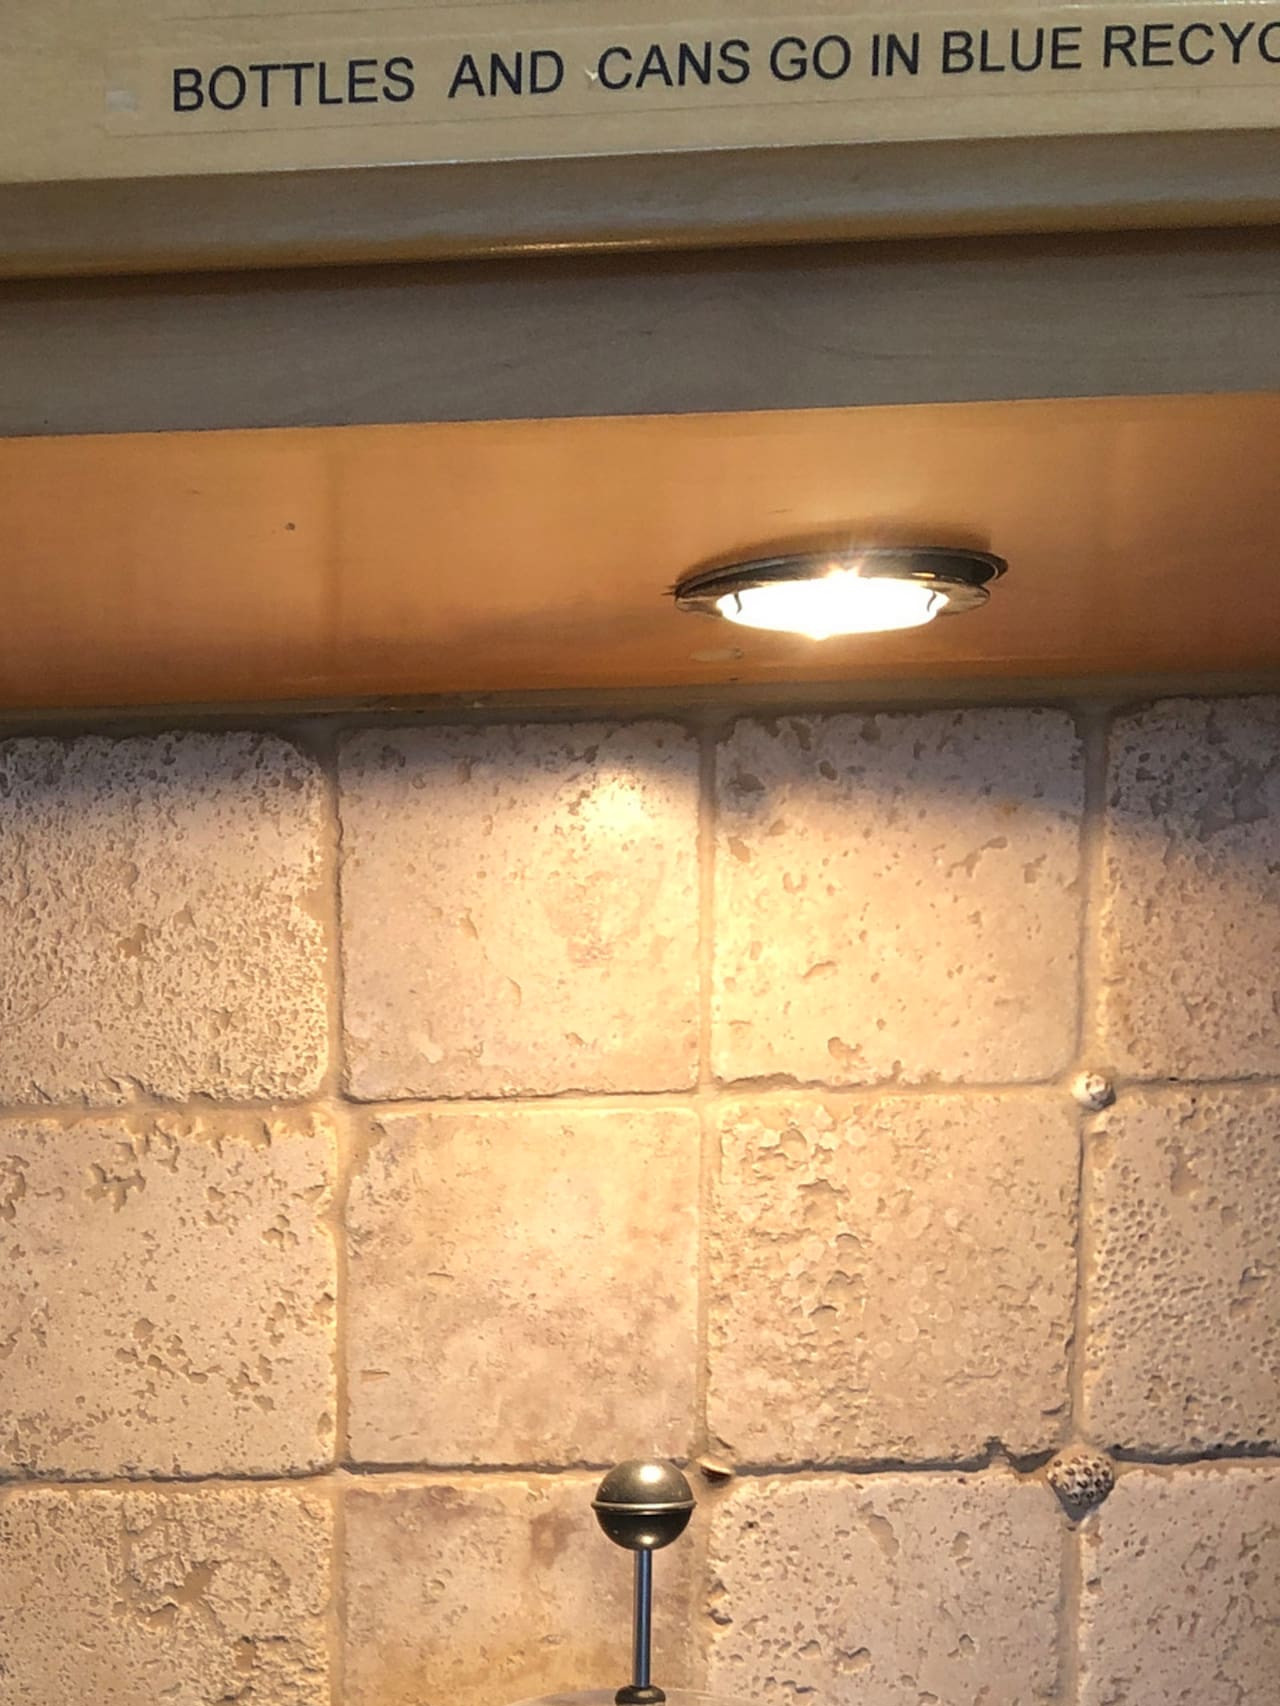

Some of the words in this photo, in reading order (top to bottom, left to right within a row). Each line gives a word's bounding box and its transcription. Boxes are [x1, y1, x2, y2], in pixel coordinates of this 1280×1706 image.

[172, 55, 416, 113] BOTTLES
[446, 49, 565, 99] AND
[596, 39, 751, 91] CANS
[768, 33, 853, 82] GO
[870, 31, 921, 77] IN
[940, 25, 1084, 75] BLUE
